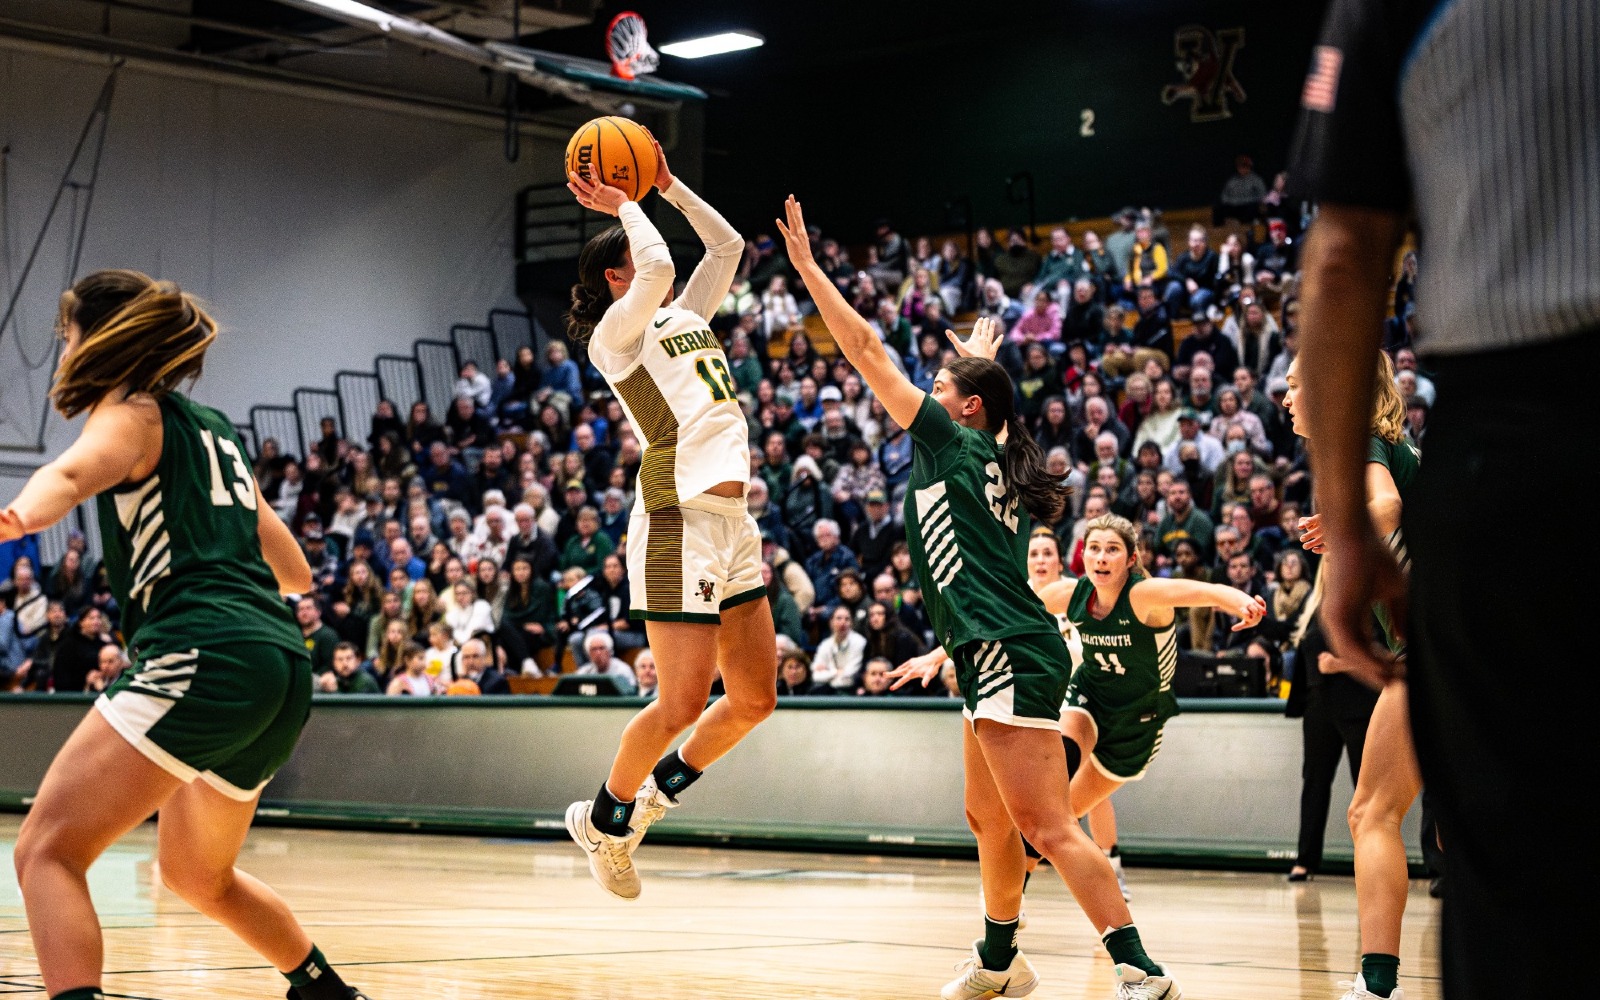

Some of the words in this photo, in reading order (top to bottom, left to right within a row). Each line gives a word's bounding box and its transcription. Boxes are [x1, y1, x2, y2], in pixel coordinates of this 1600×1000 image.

[1080, 108, 1096, 138] 2
[658, 329, 722, 358] VERMO
[694, 357, 738, 403] 12
[200, 428, 257, 511] 13
[984, 461, 1019, 535] 22
[1094, 652, 1126, 676] 11
